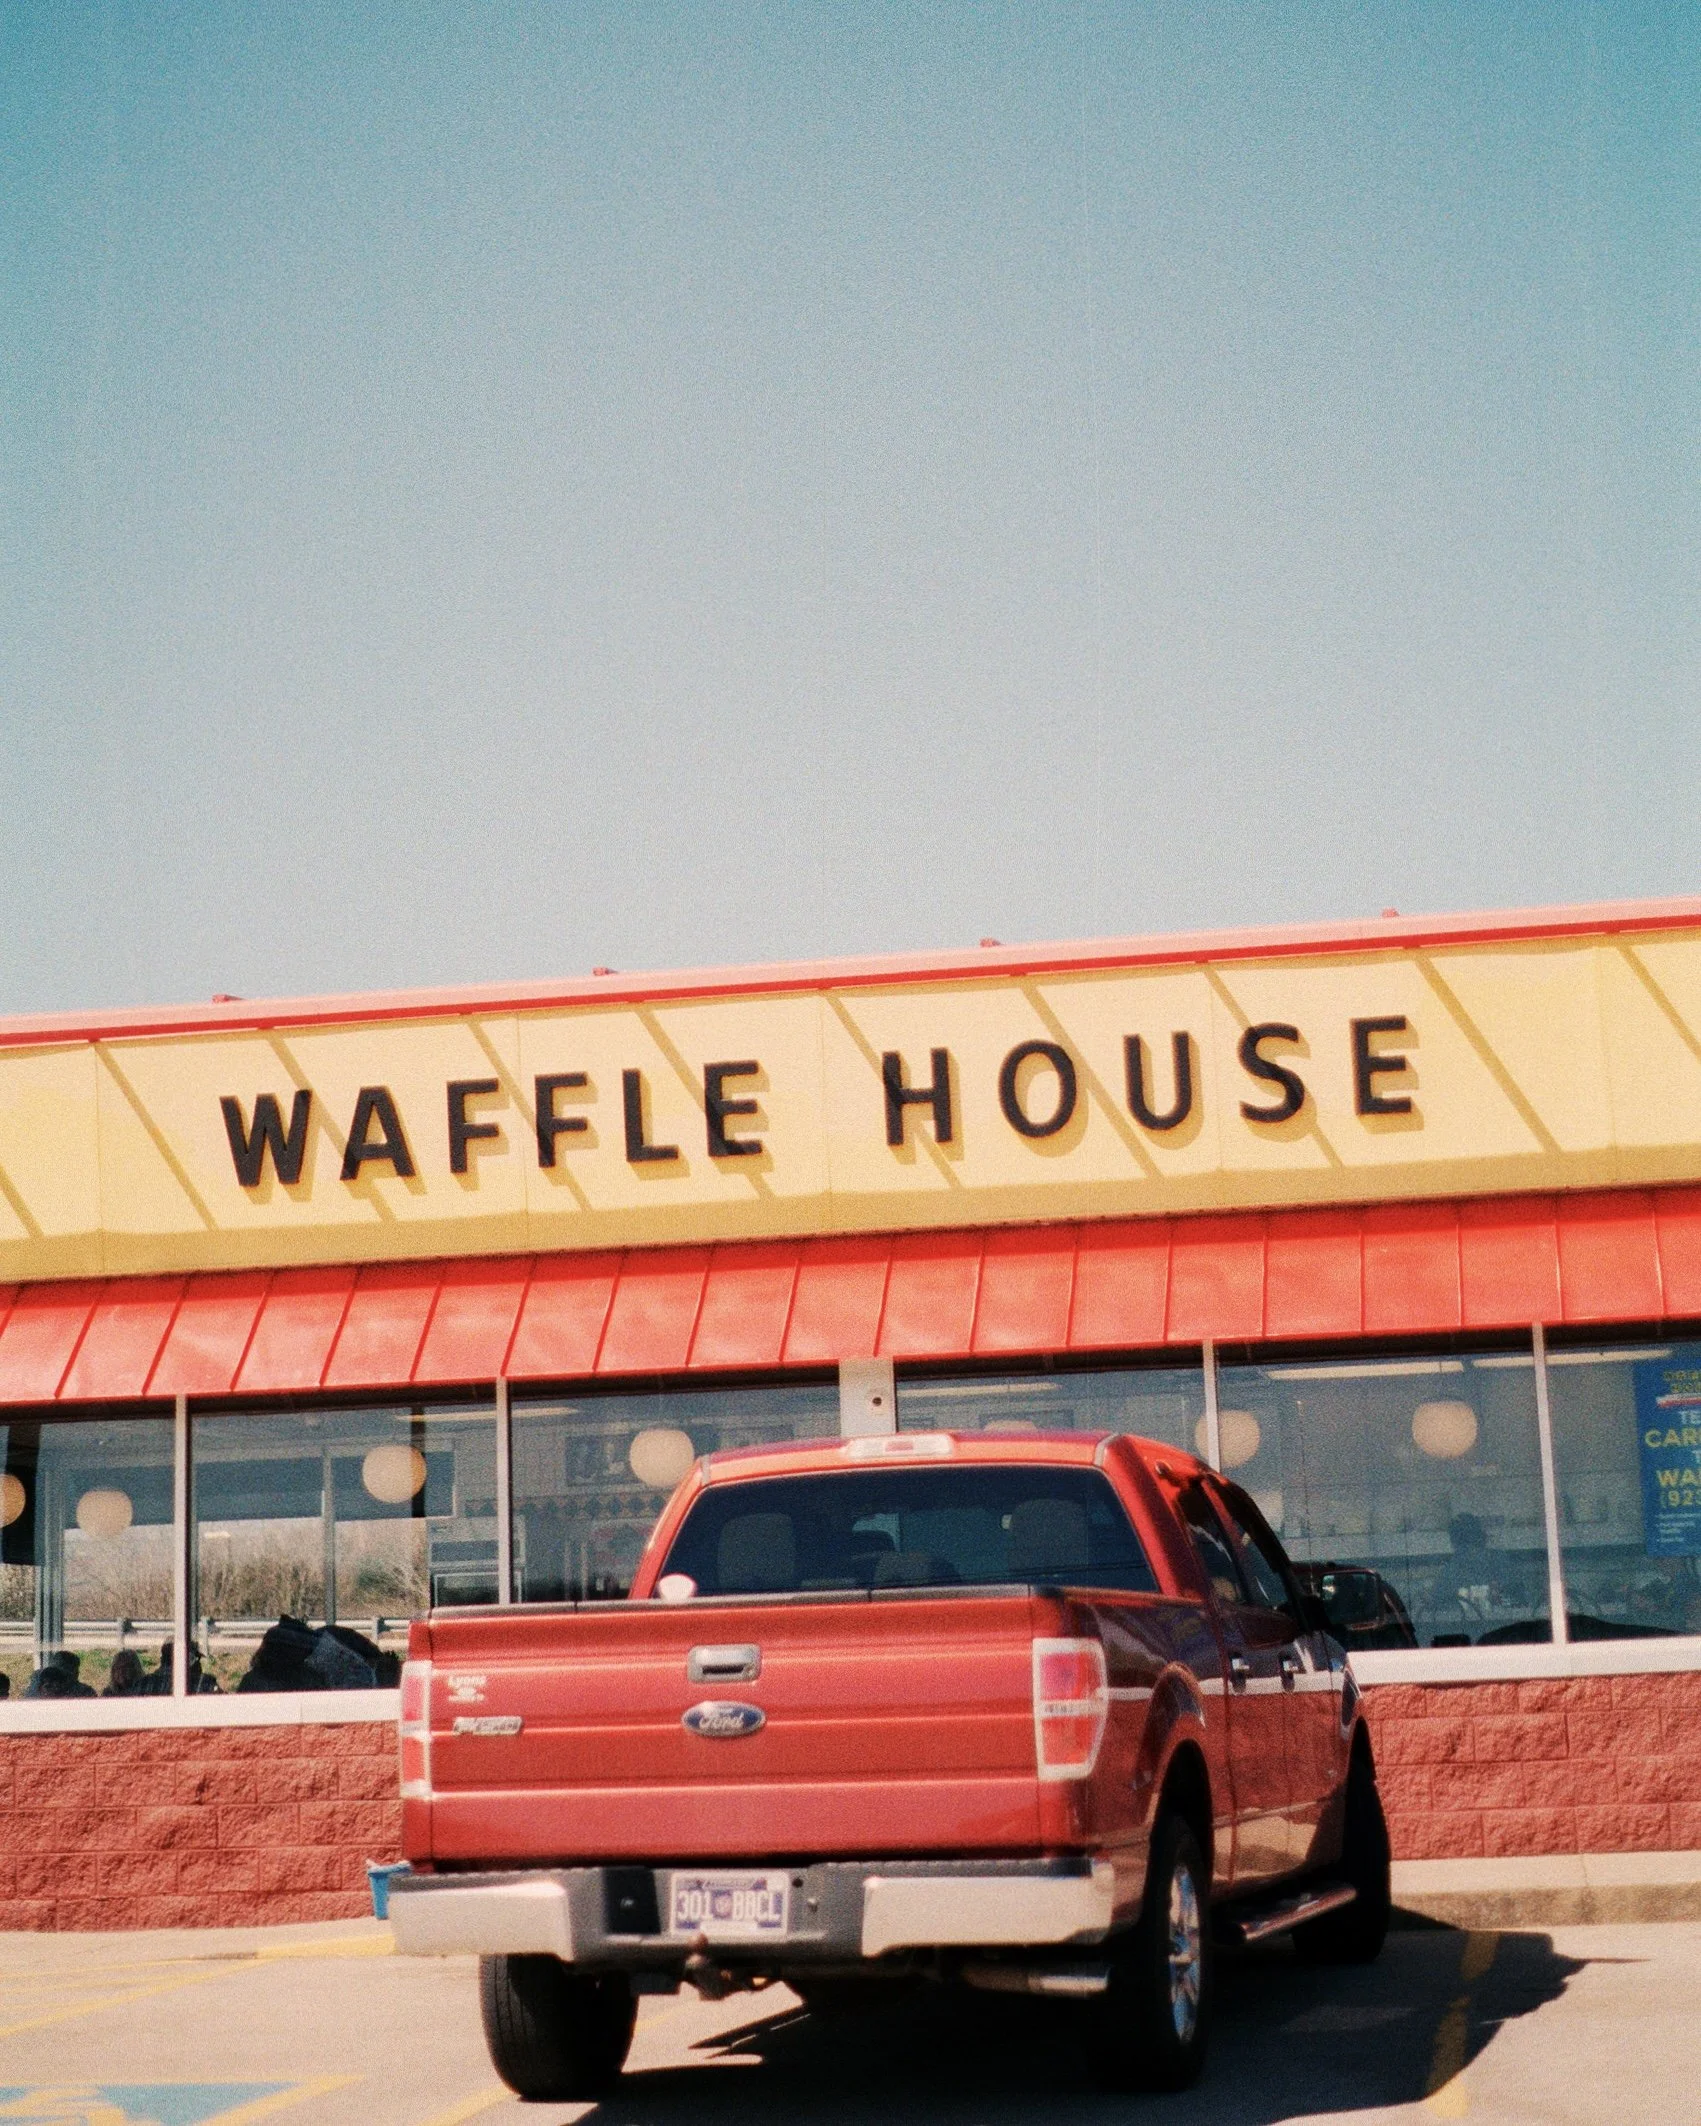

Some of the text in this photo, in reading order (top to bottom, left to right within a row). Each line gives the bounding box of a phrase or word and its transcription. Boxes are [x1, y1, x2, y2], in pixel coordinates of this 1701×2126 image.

[219, 1015, 1413, 1187] WAFFLE HOUSE
[699, 1707, 745, 1731] Ford
